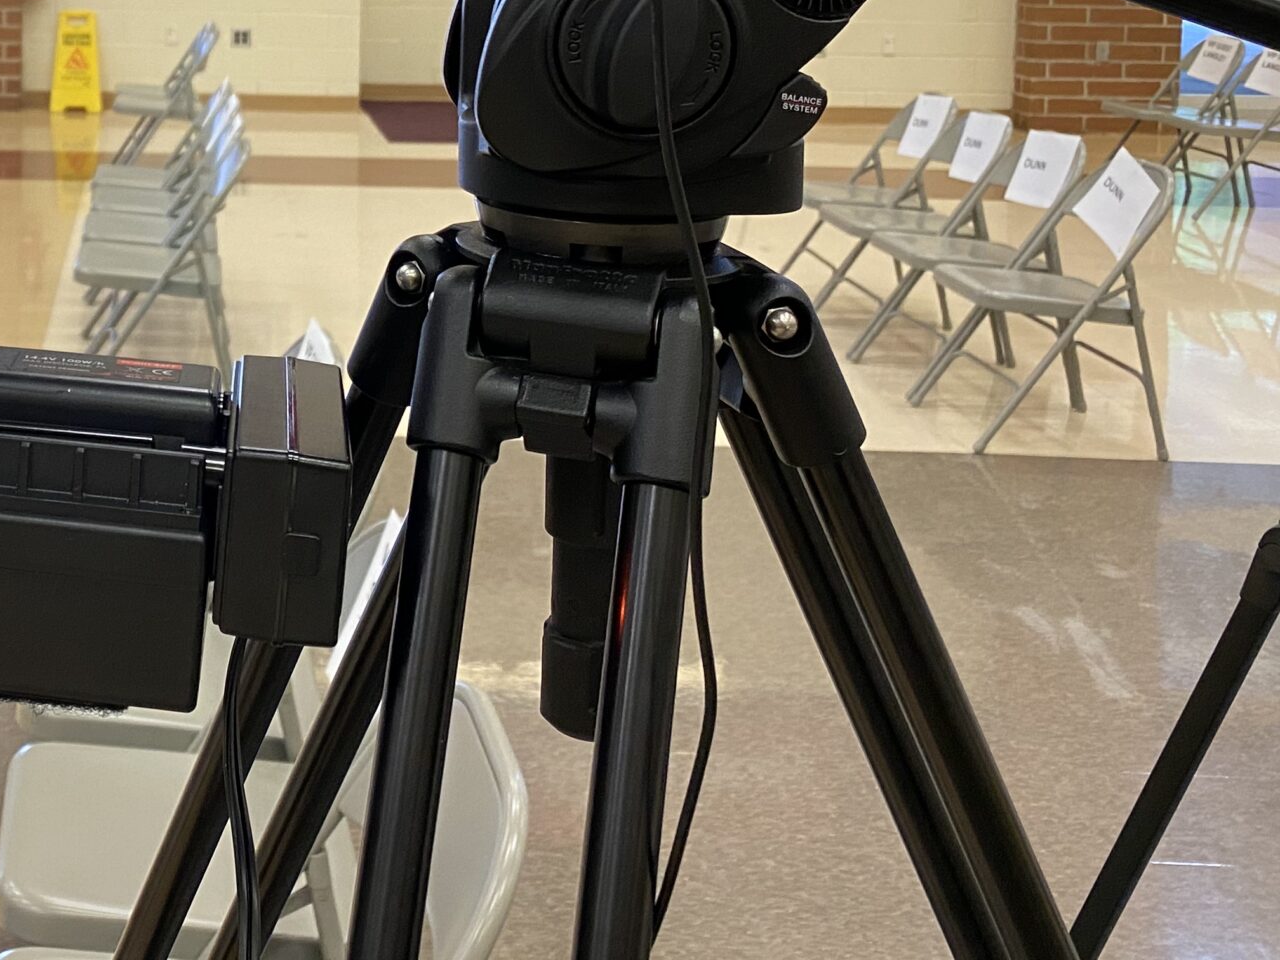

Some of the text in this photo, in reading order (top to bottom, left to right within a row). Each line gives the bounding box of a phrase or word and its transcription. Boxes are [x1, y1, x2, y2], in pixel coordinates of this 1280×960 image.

[781, 93, 822, 106] BALANCE
[782, 102, 819, 114] SYSTEM
[1023, 157, 1047, 172] DUNN
[1103, 176, 1125, 202] DUNN
